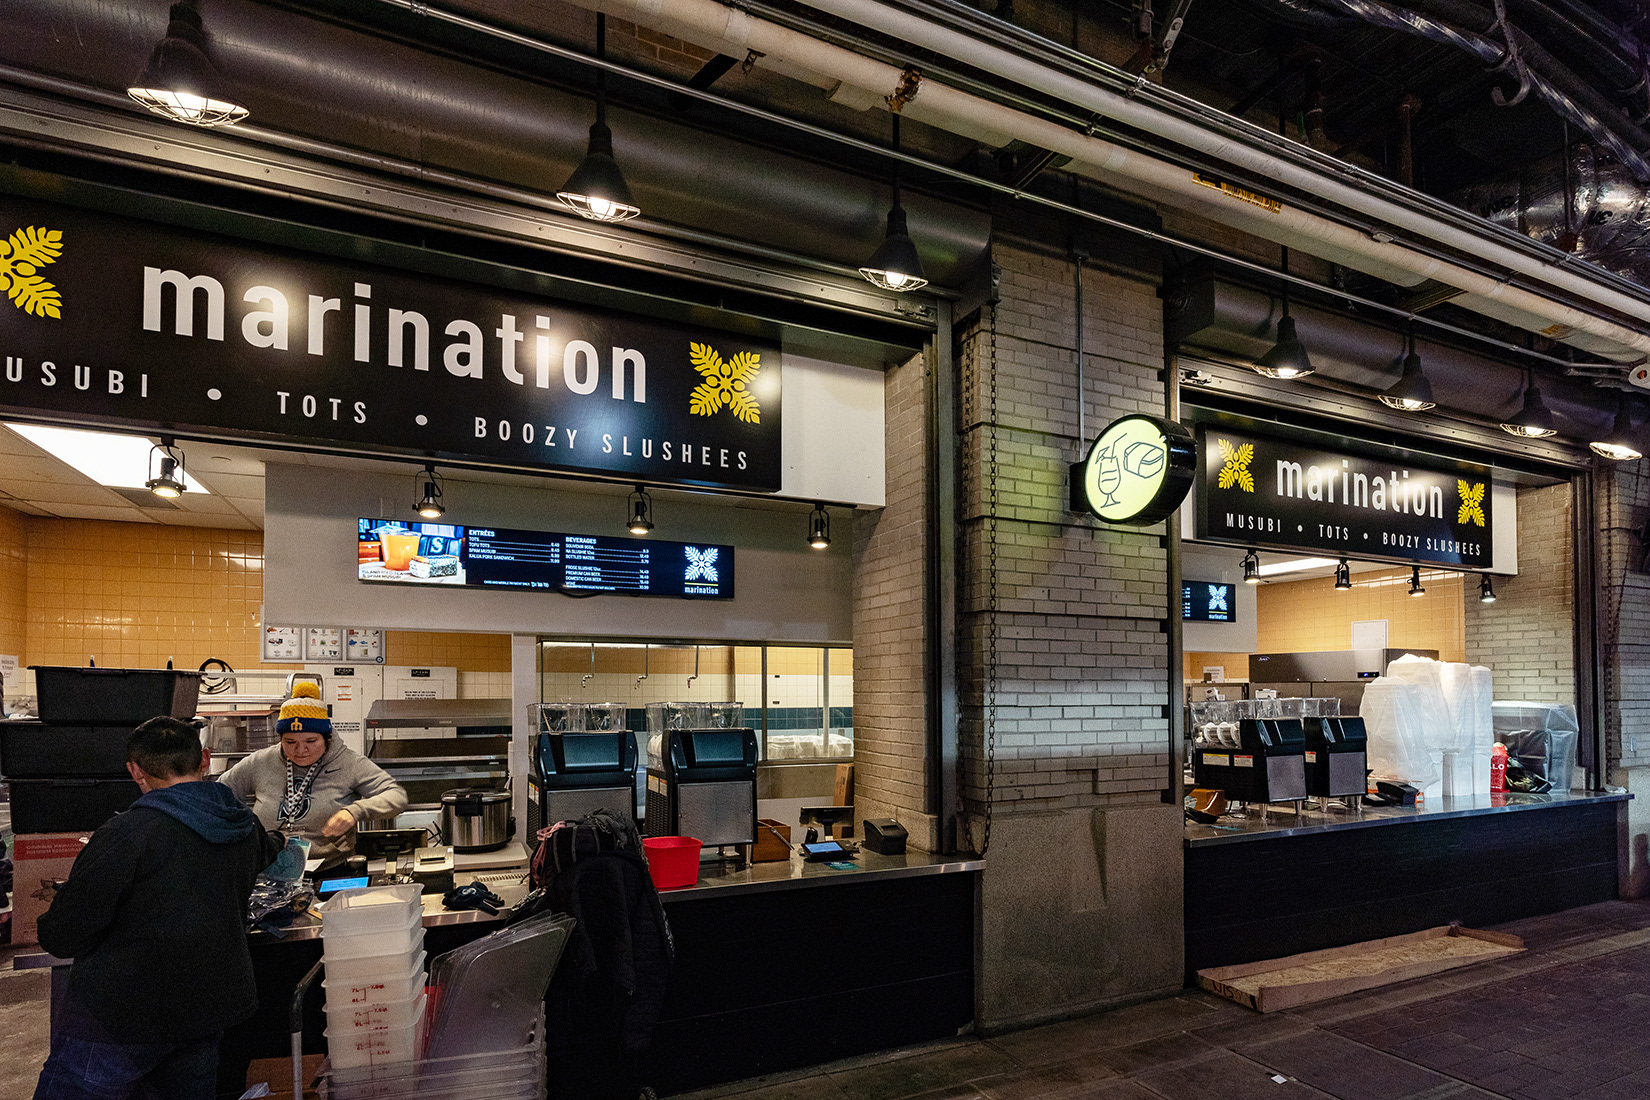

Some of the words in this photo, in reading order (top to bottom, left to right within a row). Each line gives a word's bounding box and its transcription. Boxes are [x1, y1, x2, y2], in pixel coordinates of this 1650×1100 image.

[143, 266, 645, 403] marination
[0, 356, 148, 398] USUBI
[276, 390, 367, 424] TOTS
[474, 416, 579, 449] BOOZY
[602, 433, 748, 470] SLUSHEES
[1276, 459, 1443, 519] marination
[1226, 512, 1282, 534] MUSUBI
[1318, 524, 1349, 541] TOTS
[1382, 532, 1420, 549] BOOZY
[1426, 537, 1481, 556] SLUSHEES
[684, 586, 719, 594] marination
